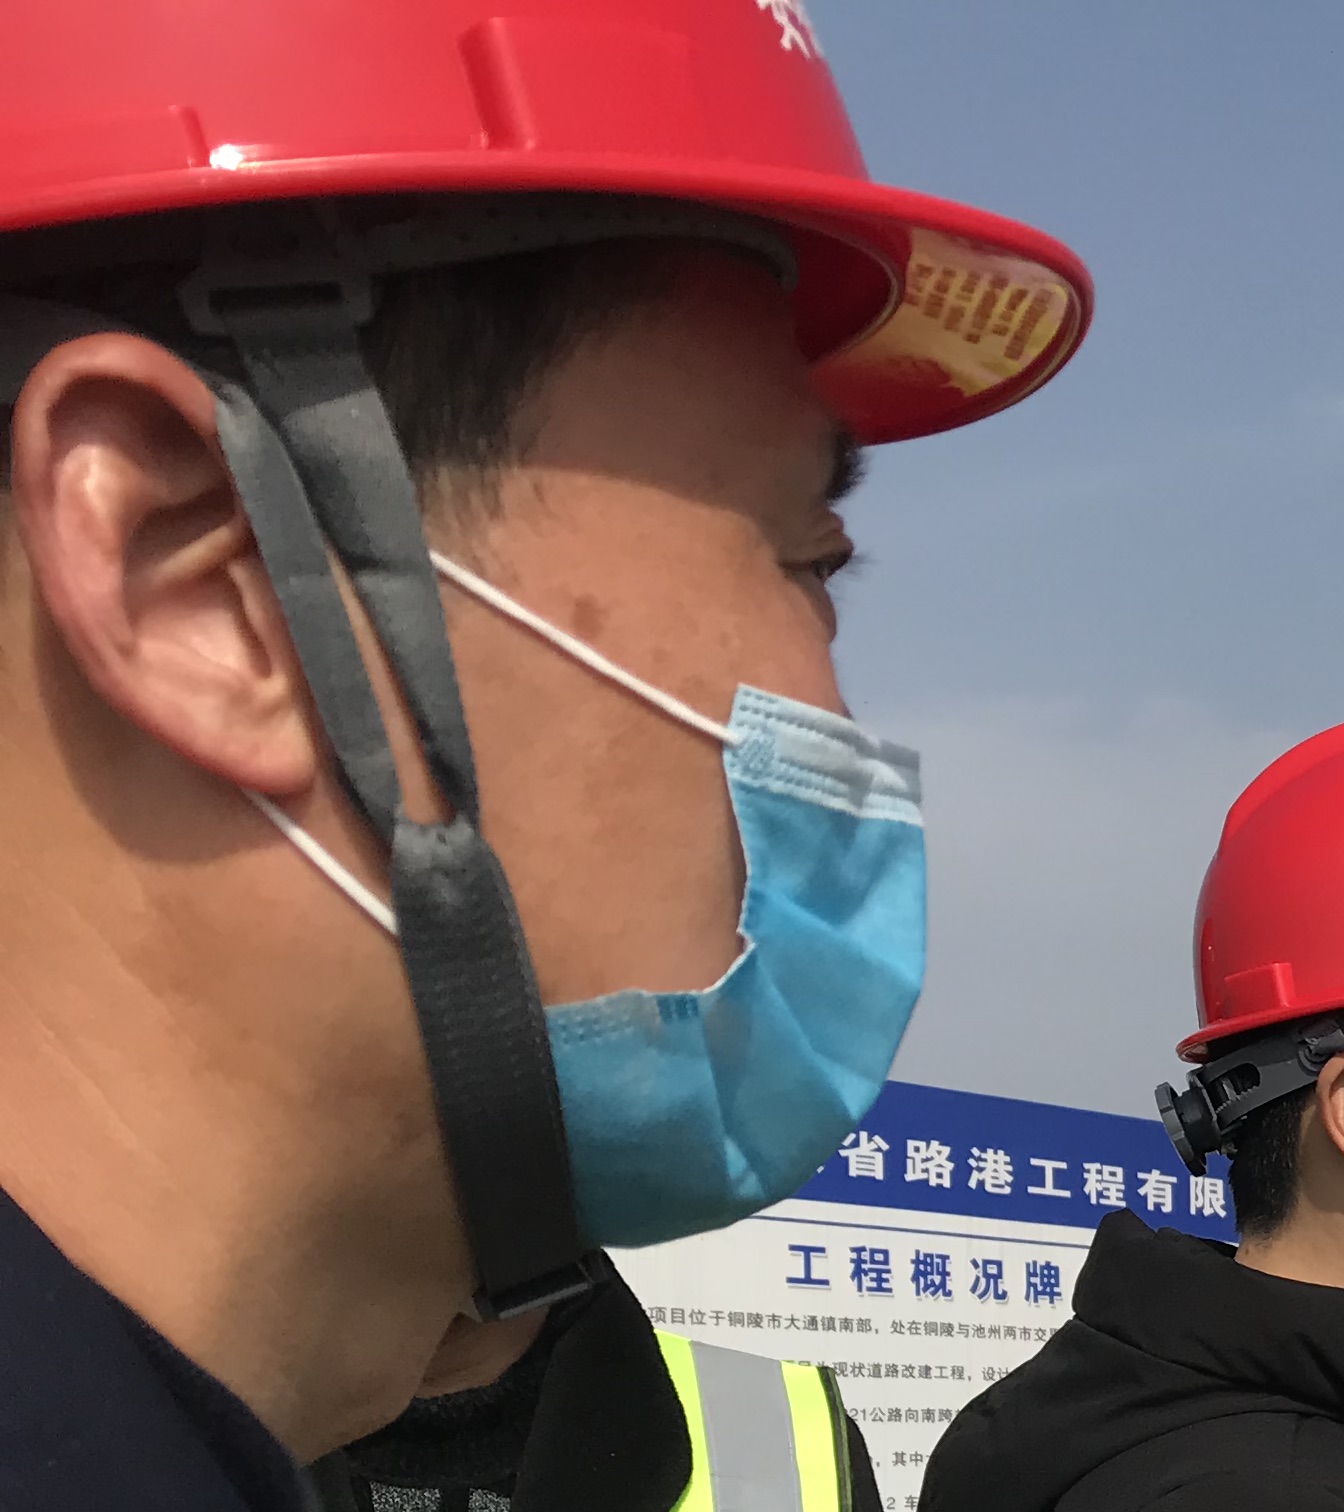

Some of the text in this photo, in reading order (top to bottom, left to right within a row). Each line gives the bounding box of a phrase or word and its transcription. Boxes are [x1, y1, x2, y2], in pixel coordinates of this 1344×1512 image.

[817, 1130, 1227, 1218] 省路港工程有限
[786, 1244, 1063, 1305] 工程概况牌
[783, 1360, 1012, 1383] 现状道路改建工程，设计
